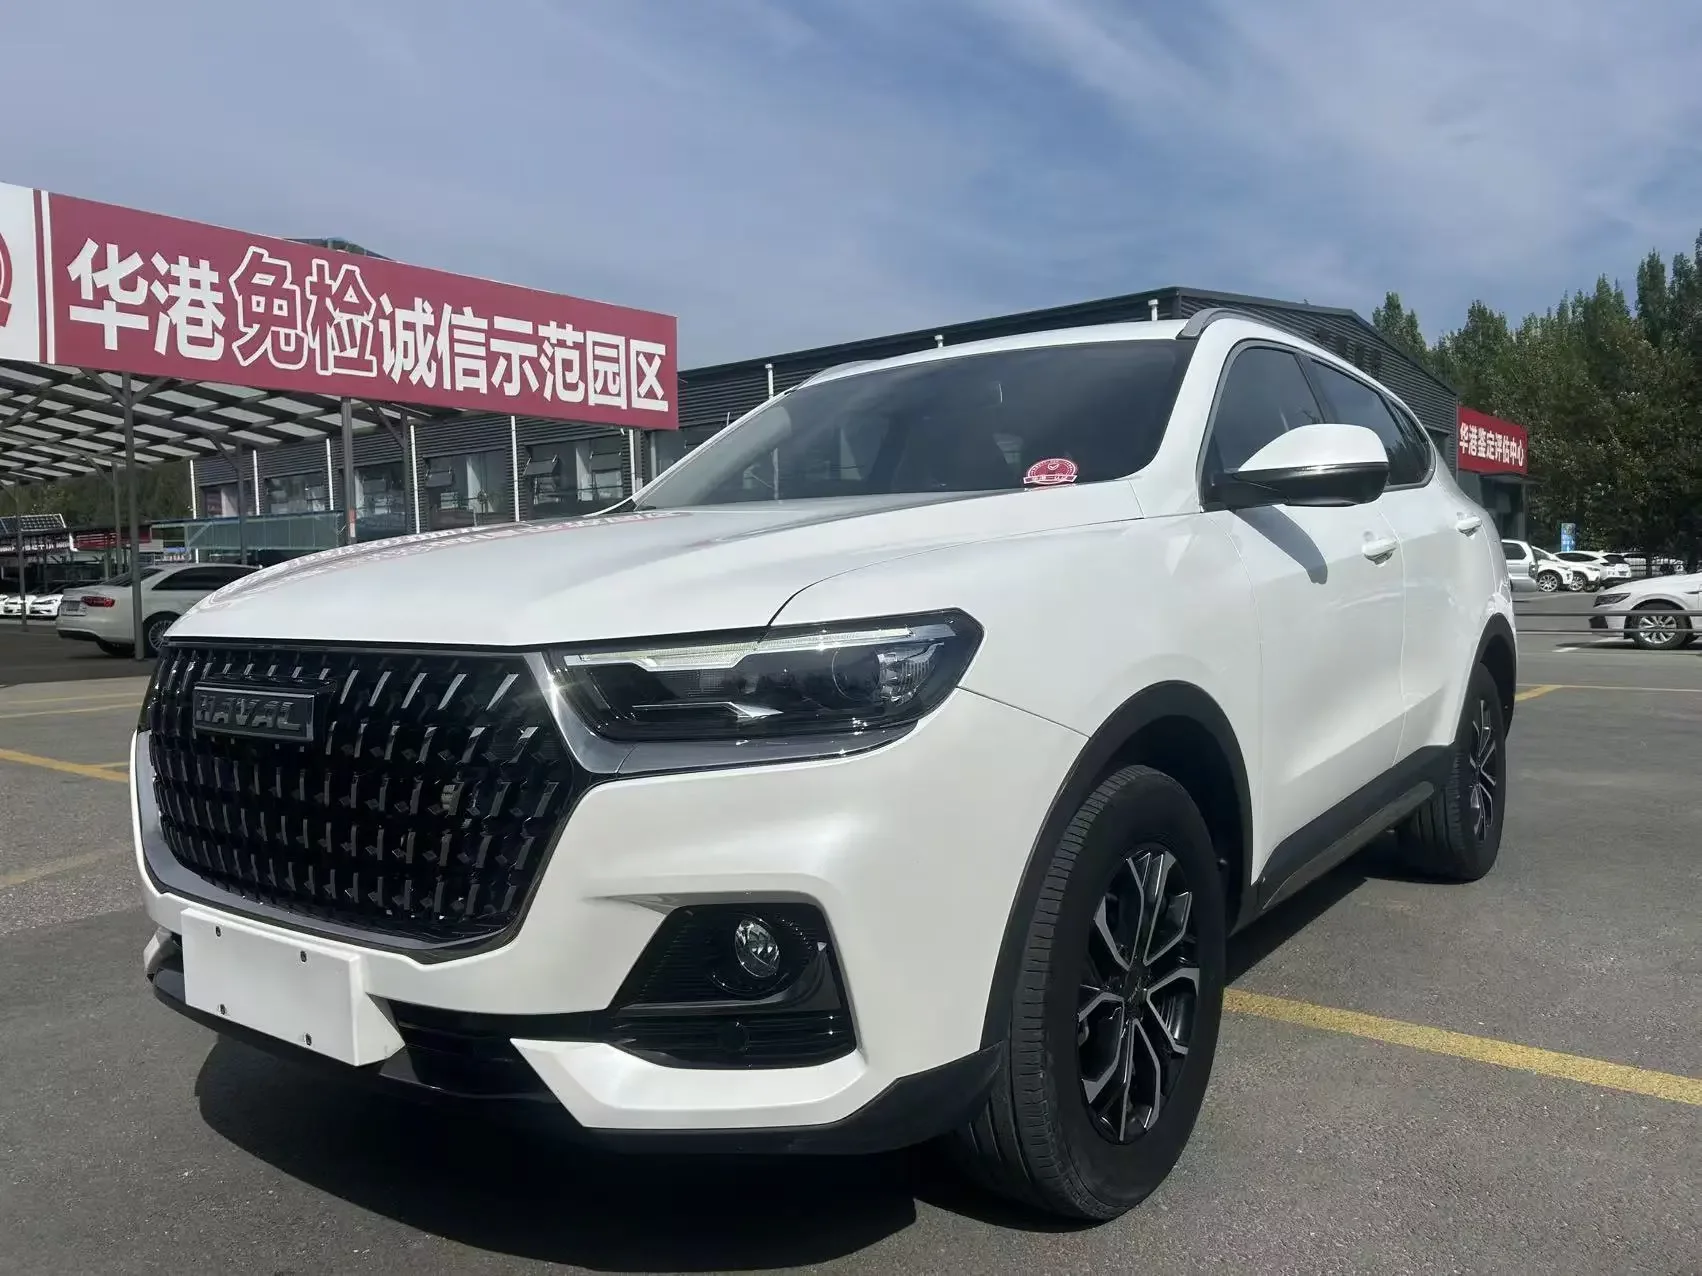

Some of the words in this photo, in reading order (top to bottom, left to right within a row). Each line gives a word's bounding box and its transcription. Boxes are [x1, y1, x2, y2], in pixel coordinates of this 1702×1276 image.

[67, 238, 669, 412] 华港免检诚信示范园区
[1459, 422, 1524, 467] 华港鉴定评估中心
[195, 695, 301, 730] HAVAL
